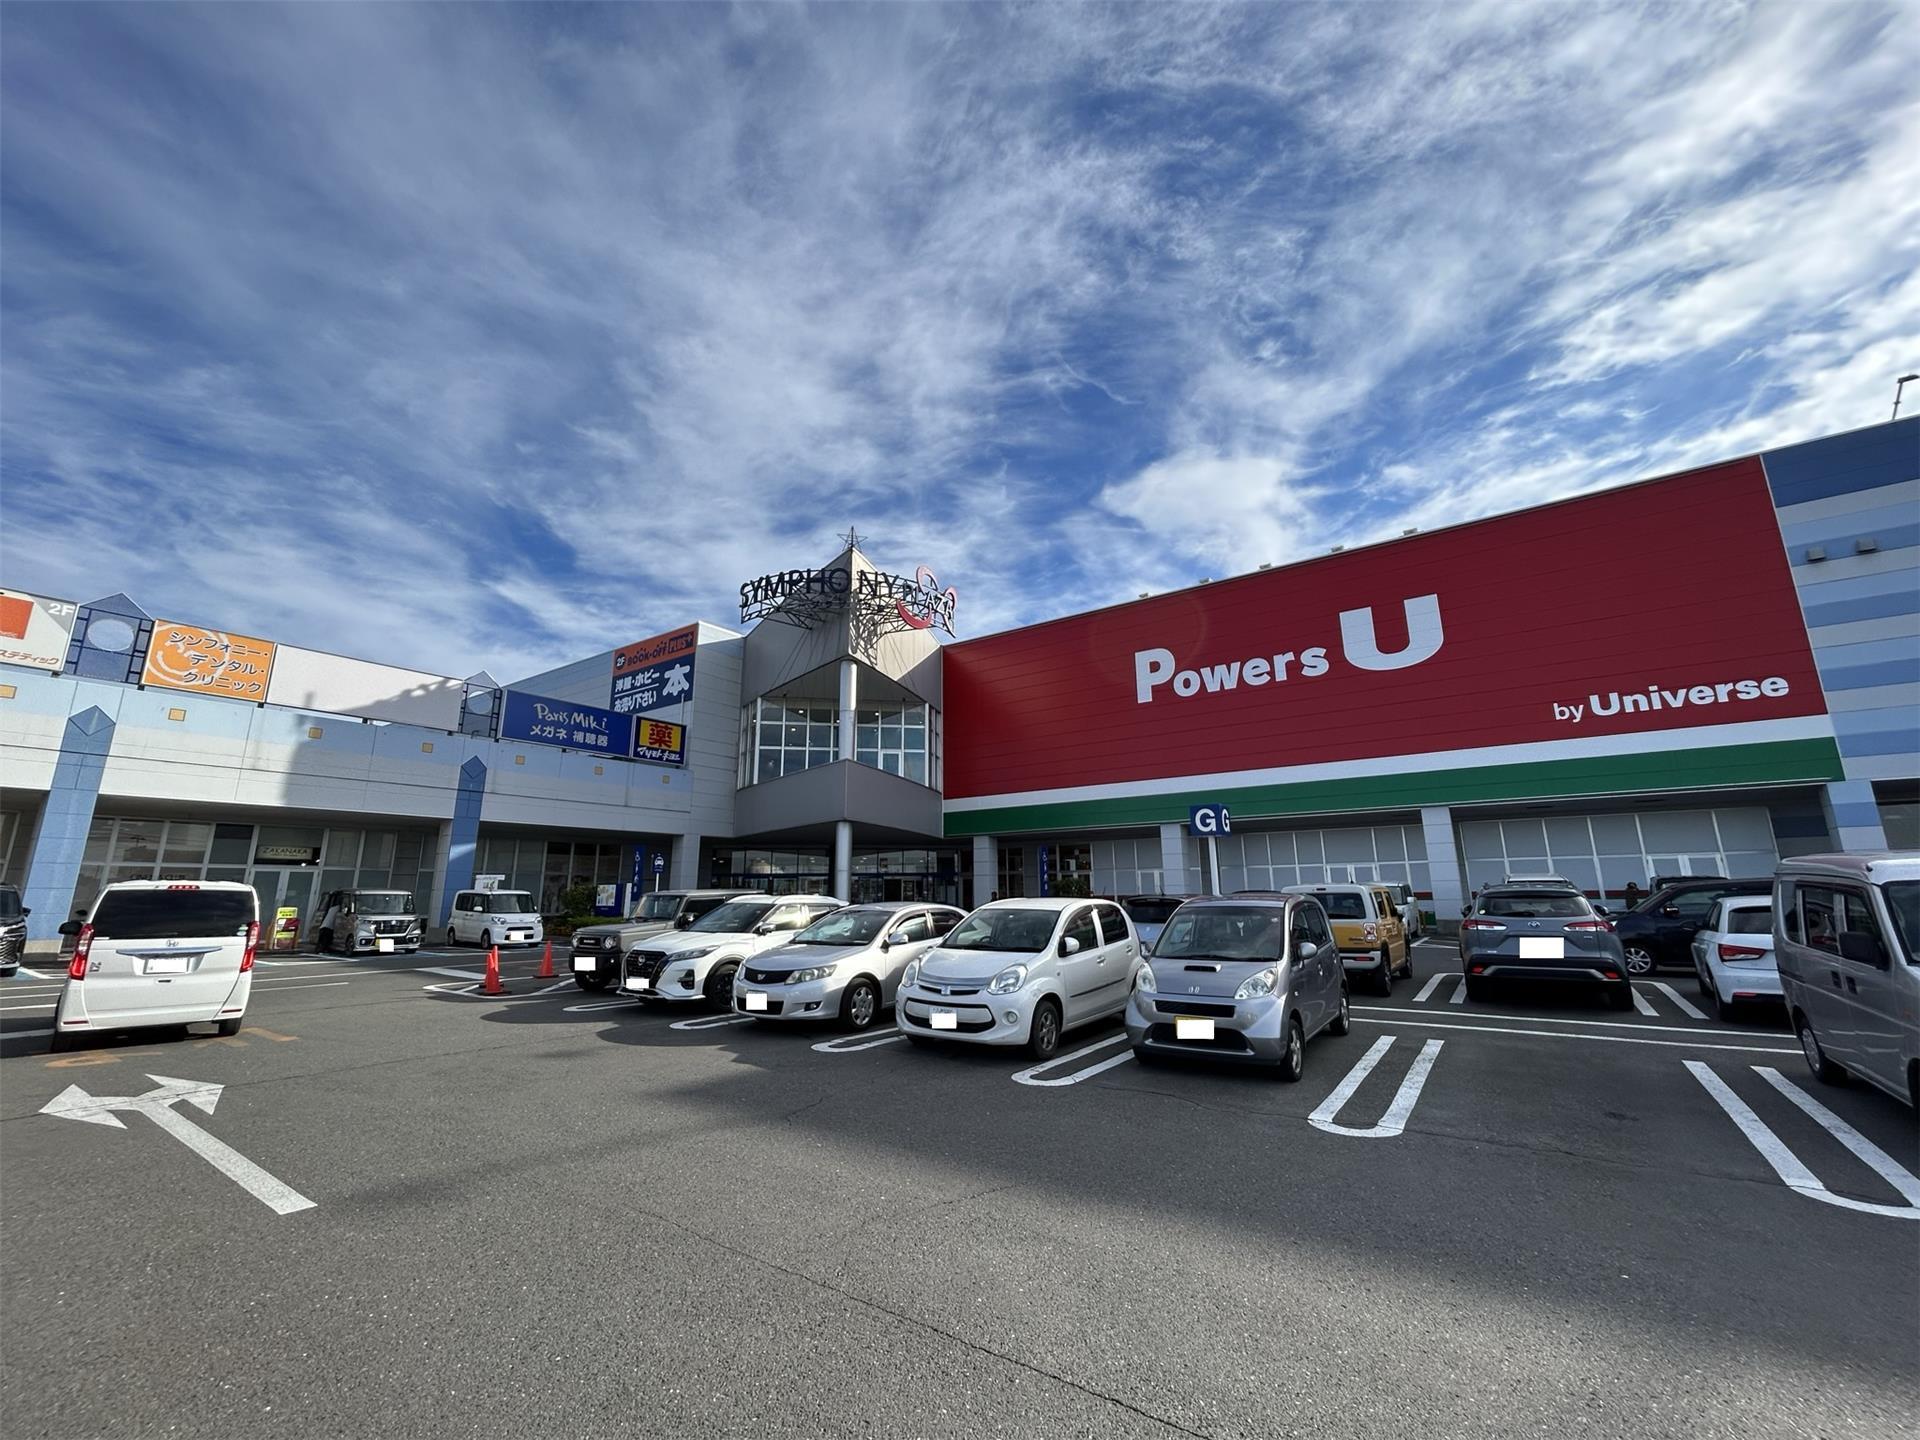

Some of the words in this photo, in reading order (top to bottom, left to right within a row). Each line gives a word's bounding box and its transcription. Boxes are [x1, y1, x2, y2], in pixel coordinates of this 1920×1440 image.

[47, 602, 76, 616] 2F
[1134, 647, 1330, 704] Powers
[1339, 593, 1444, 671] U
[616, 656, 626, 667] 2F
[183, 671, 262, 693] クリニック
[662, 663, 691, 697] 本
[1552, 702, 1584, 723] by
[1589, 676, 1789, 716] Universe
[533, 703, 569, 725] Paris
[570, 711, 609, 733] Miki
[530, 724, 568, 740] メガネ
[572, 730, 609, 747] 補聴器
[648, 722, 673, 749] 薬
[1195, 808, 1217, 832] G
[1221, 808, 1231, 832] G
